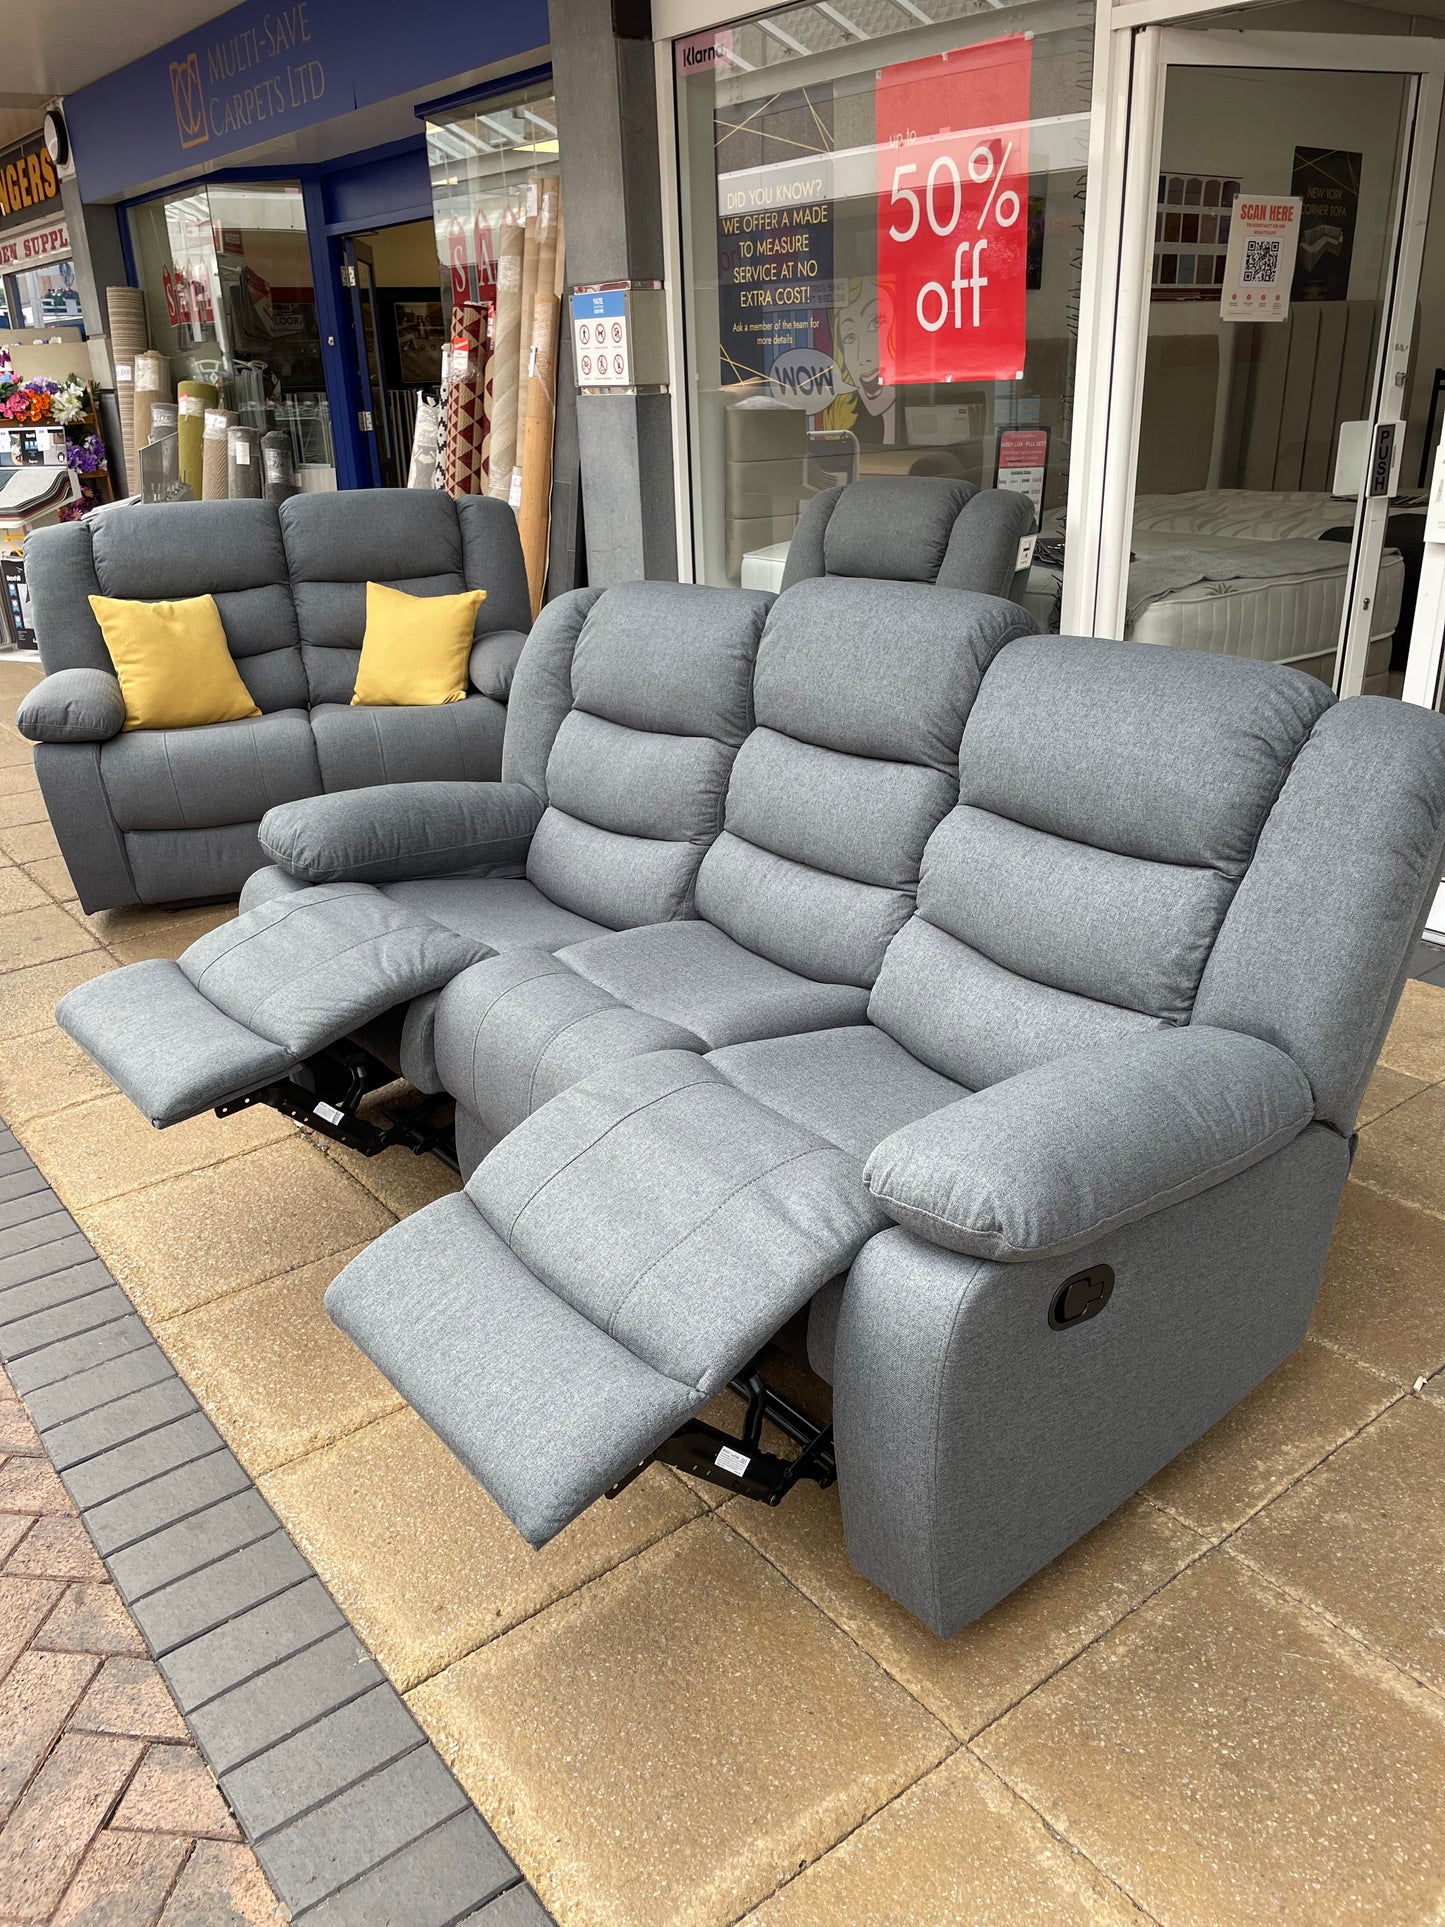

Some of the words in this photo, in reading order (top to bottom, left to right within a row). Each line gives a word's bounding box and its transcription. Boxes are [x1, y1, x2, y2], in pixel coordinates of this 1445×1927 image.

[206, 2, 312, 84] MULTI-SAVE
[209, 76, 285, 136] CARPETS
[286, 60, 325, 108] LTD
[890, 132, 904, 148] up
[906, 128, 917, 142] to
[728, 193, 746, 209] DID
[749, 187, 772, 206] YOU
[776, 179, 822, 202] KNOW?
[888, 142, 1020, 242] 50%
[1306, 187, 1324, 200] NEW
[1326, 188, 1344, 200] YORK
[722, 217, 740, 235] WE
[743, 212, 778, 233] OFFER
[781, 211, 790, 227] A
[792, 205, 828, 226] MADE
[1240, 204, 1267, 220] SCAN
[1269, 205, 1294, 222] HERE
[1330, 206, 1347, 217] SOFA
[738, 241, 754, 258] TO
[757, 234, 810, 256] MEASURE
[734, 264, 777, 284] SERVICE
[780, 262, 794, 280] AT
[798, 260, 818, 278] NO
[740, 290, 772, 308] EXTRA
[776, 286, 810, 305] COST!
[916, 238, 988, 332] off
[732, 323, 744, 332] Ask
[749, 322, 773, 332] member
[774, 320, 782, 331] of
[782, 319, 792, 330] the
[793, 320, 809, 330] team
[810, 317, 820, 329] for
[757, 336, 772, 345] more
[773, 335, 793, 345] details
[1374, 430, 1390, 491] PUSH
